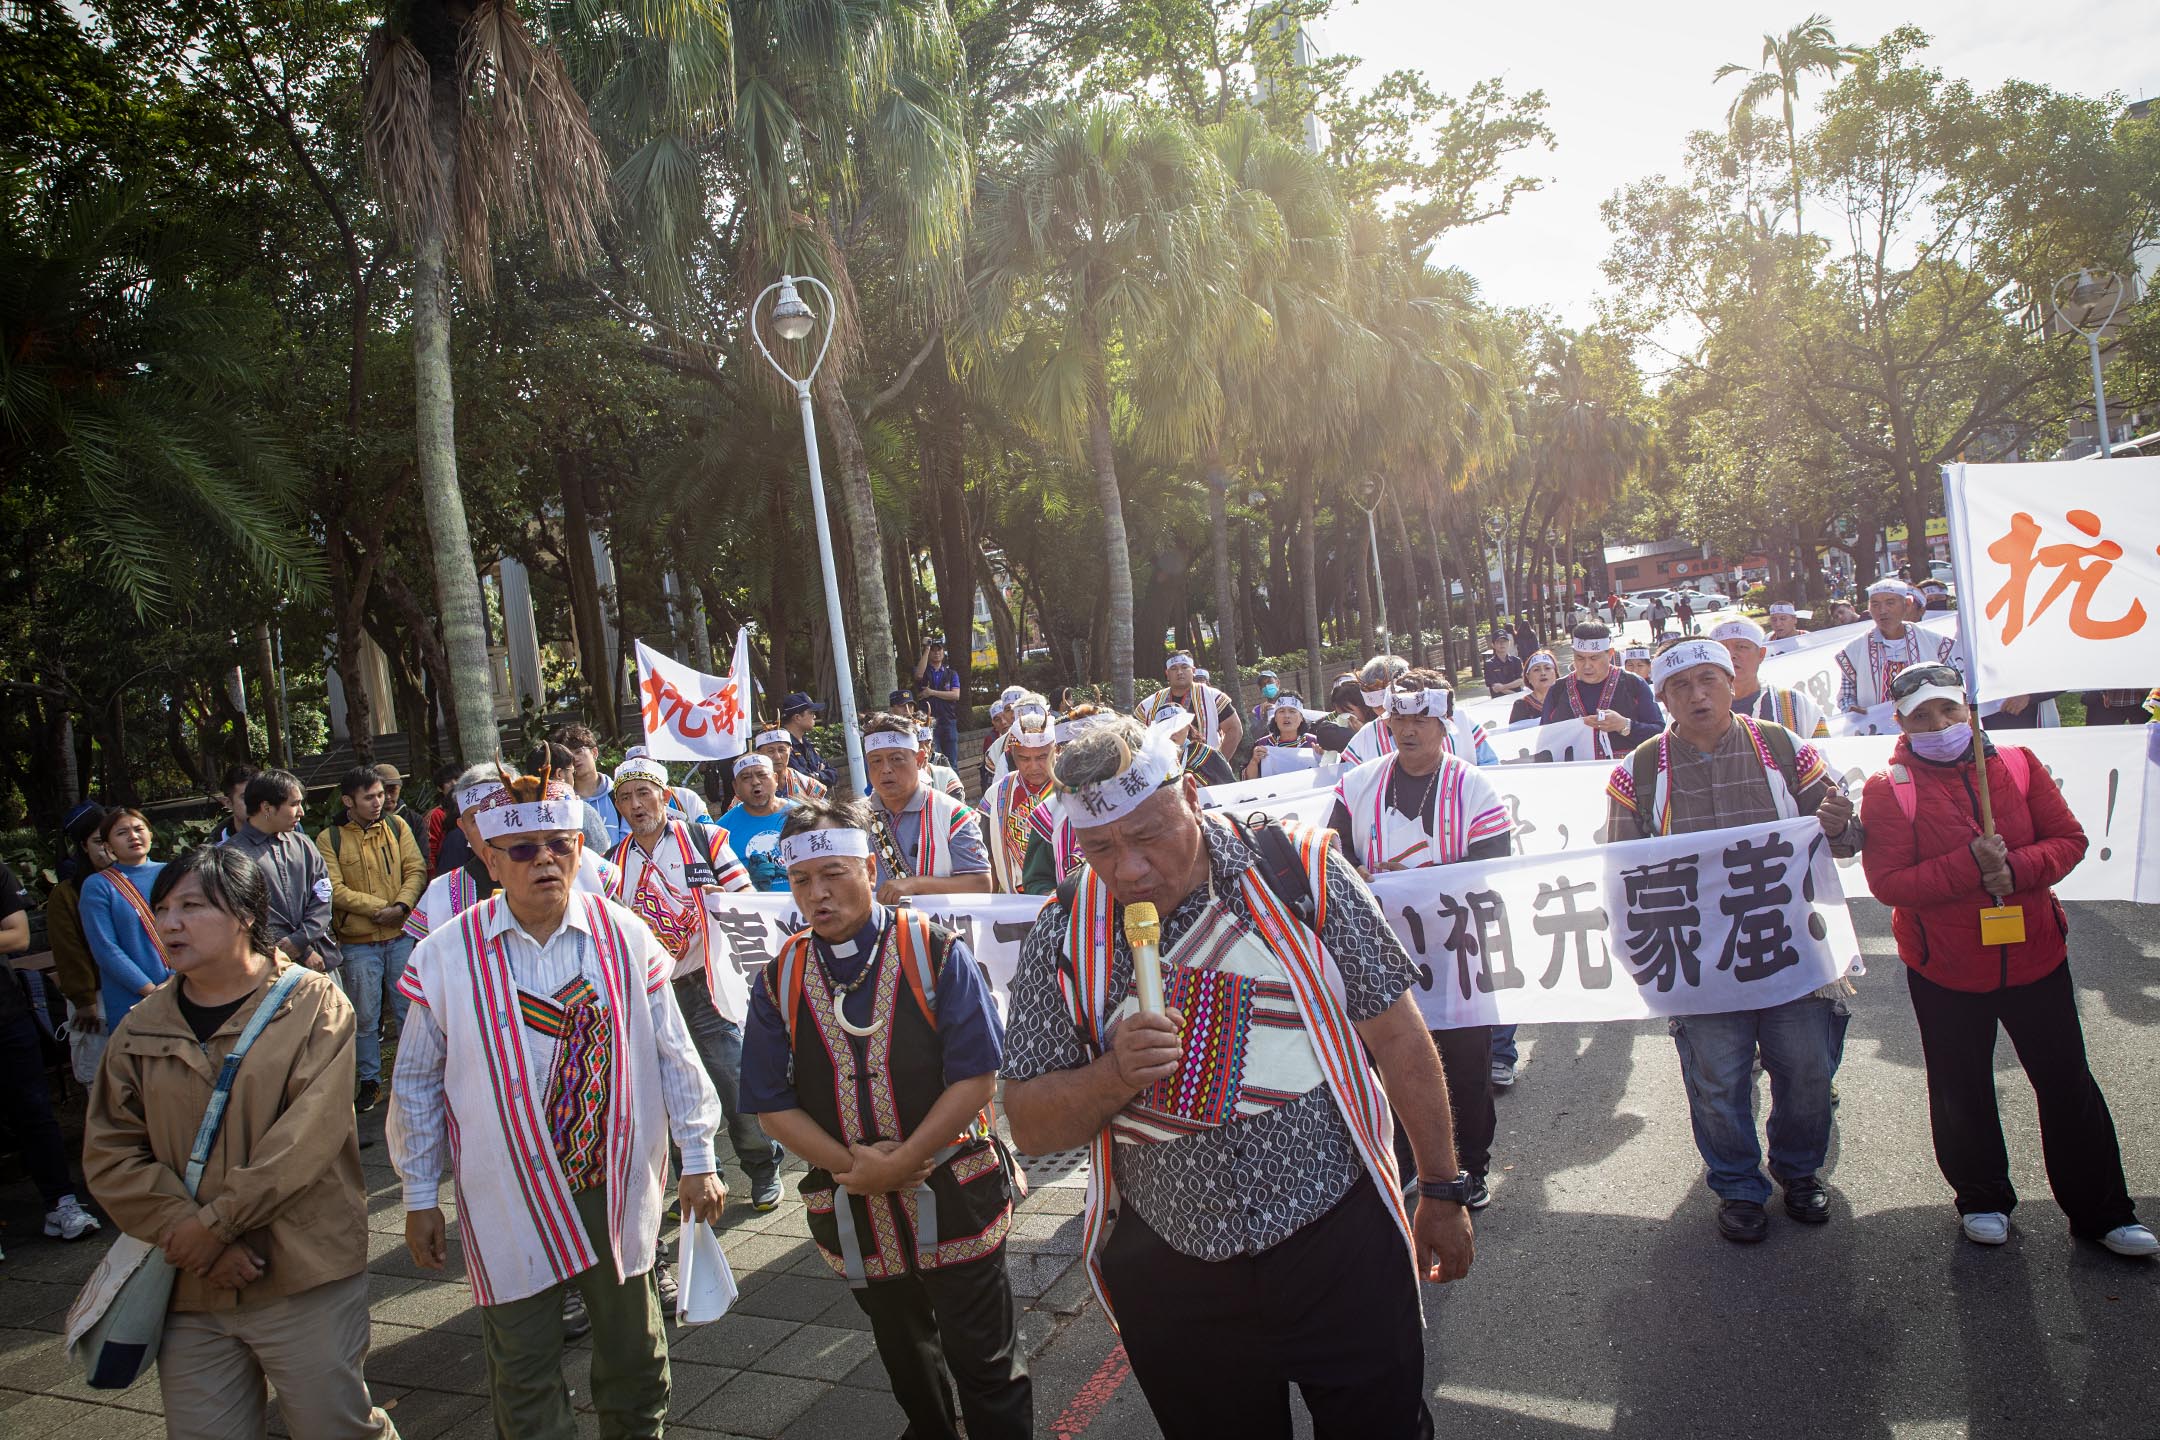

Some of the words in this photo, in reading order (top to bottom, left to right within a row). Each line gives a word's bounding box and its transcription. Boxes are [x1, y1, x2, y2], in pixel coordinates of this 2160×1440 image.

[1985, 509, 2160, 646] 抗
[1665, 644, 1710, 668] 抗議
[1081, 767, 1150, 818] 抗議
[503, 804, 556, 828] 抗議
[783, 830, 834, 861] 抗議
[1374, 831, 1829, 1000] !祖先蒙羞!
